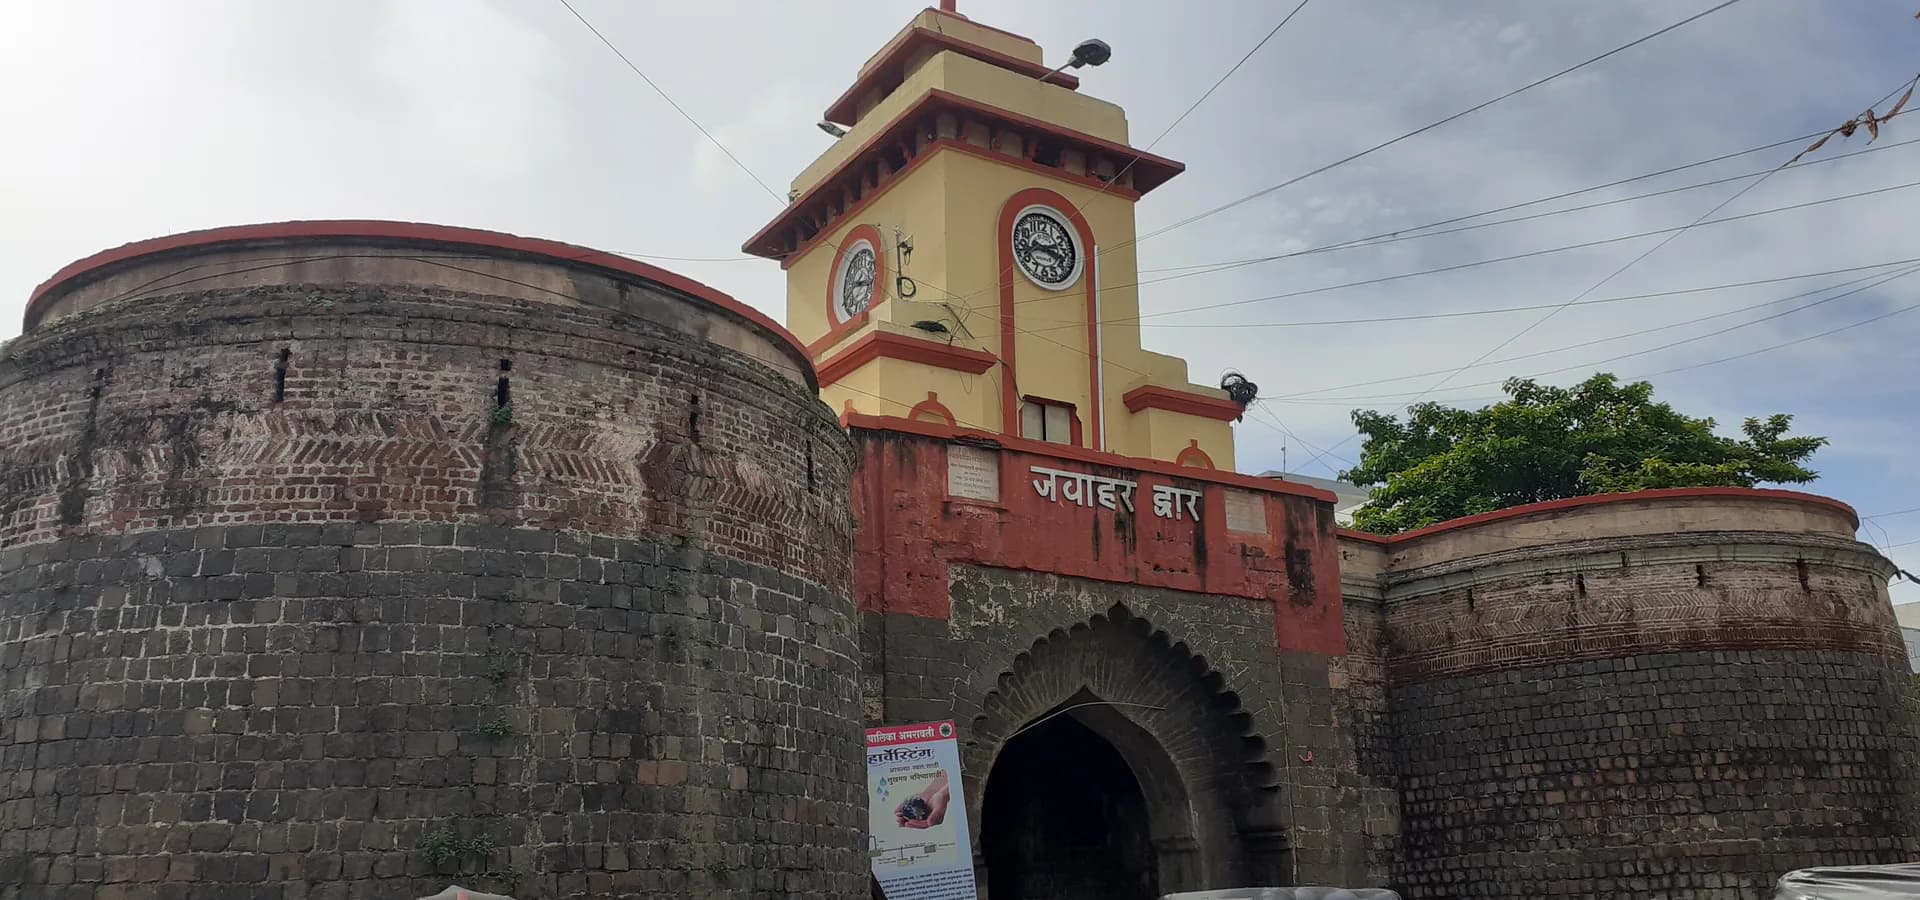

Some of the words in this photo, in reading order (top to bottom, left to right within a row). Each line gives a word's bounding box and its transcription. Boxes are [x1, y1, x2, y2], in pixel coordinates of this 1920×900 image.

[1030, 465, 1138, 513] जवाहर
[1152, 485, 1203, 523] द्वार
[866, 730, 897, 745] पालिका
[899, 725, 934, 741] अमरावती
